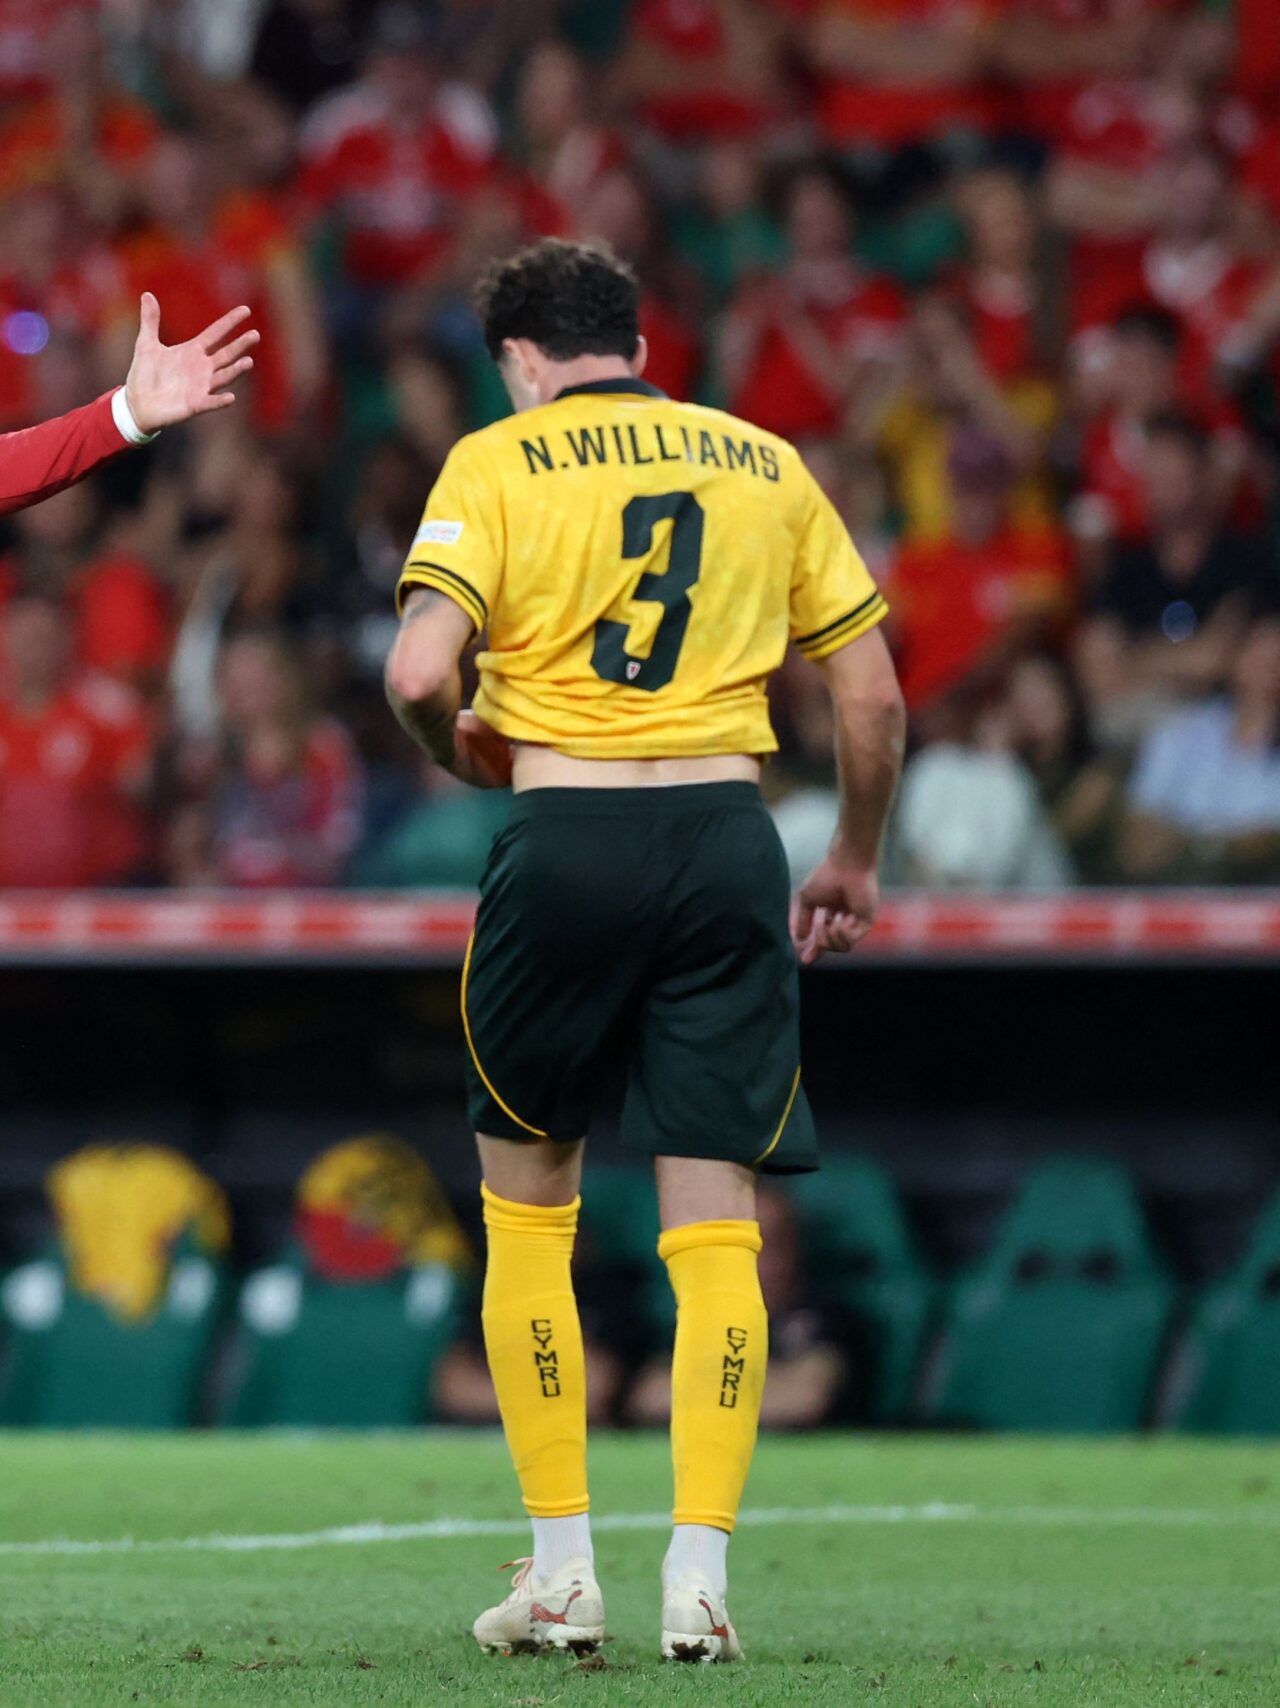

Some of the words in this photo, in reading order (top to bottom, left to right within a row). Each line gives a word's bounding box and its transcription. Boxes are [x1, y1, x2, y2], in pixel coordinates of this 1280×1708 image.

[521, 424, 779, 482] N.WILLIAMS
[590, 491, 705, 692] 3
[531, 1319, 561, 1397] CYMRU
[719, 1327, 748, 1408] CYMRU
